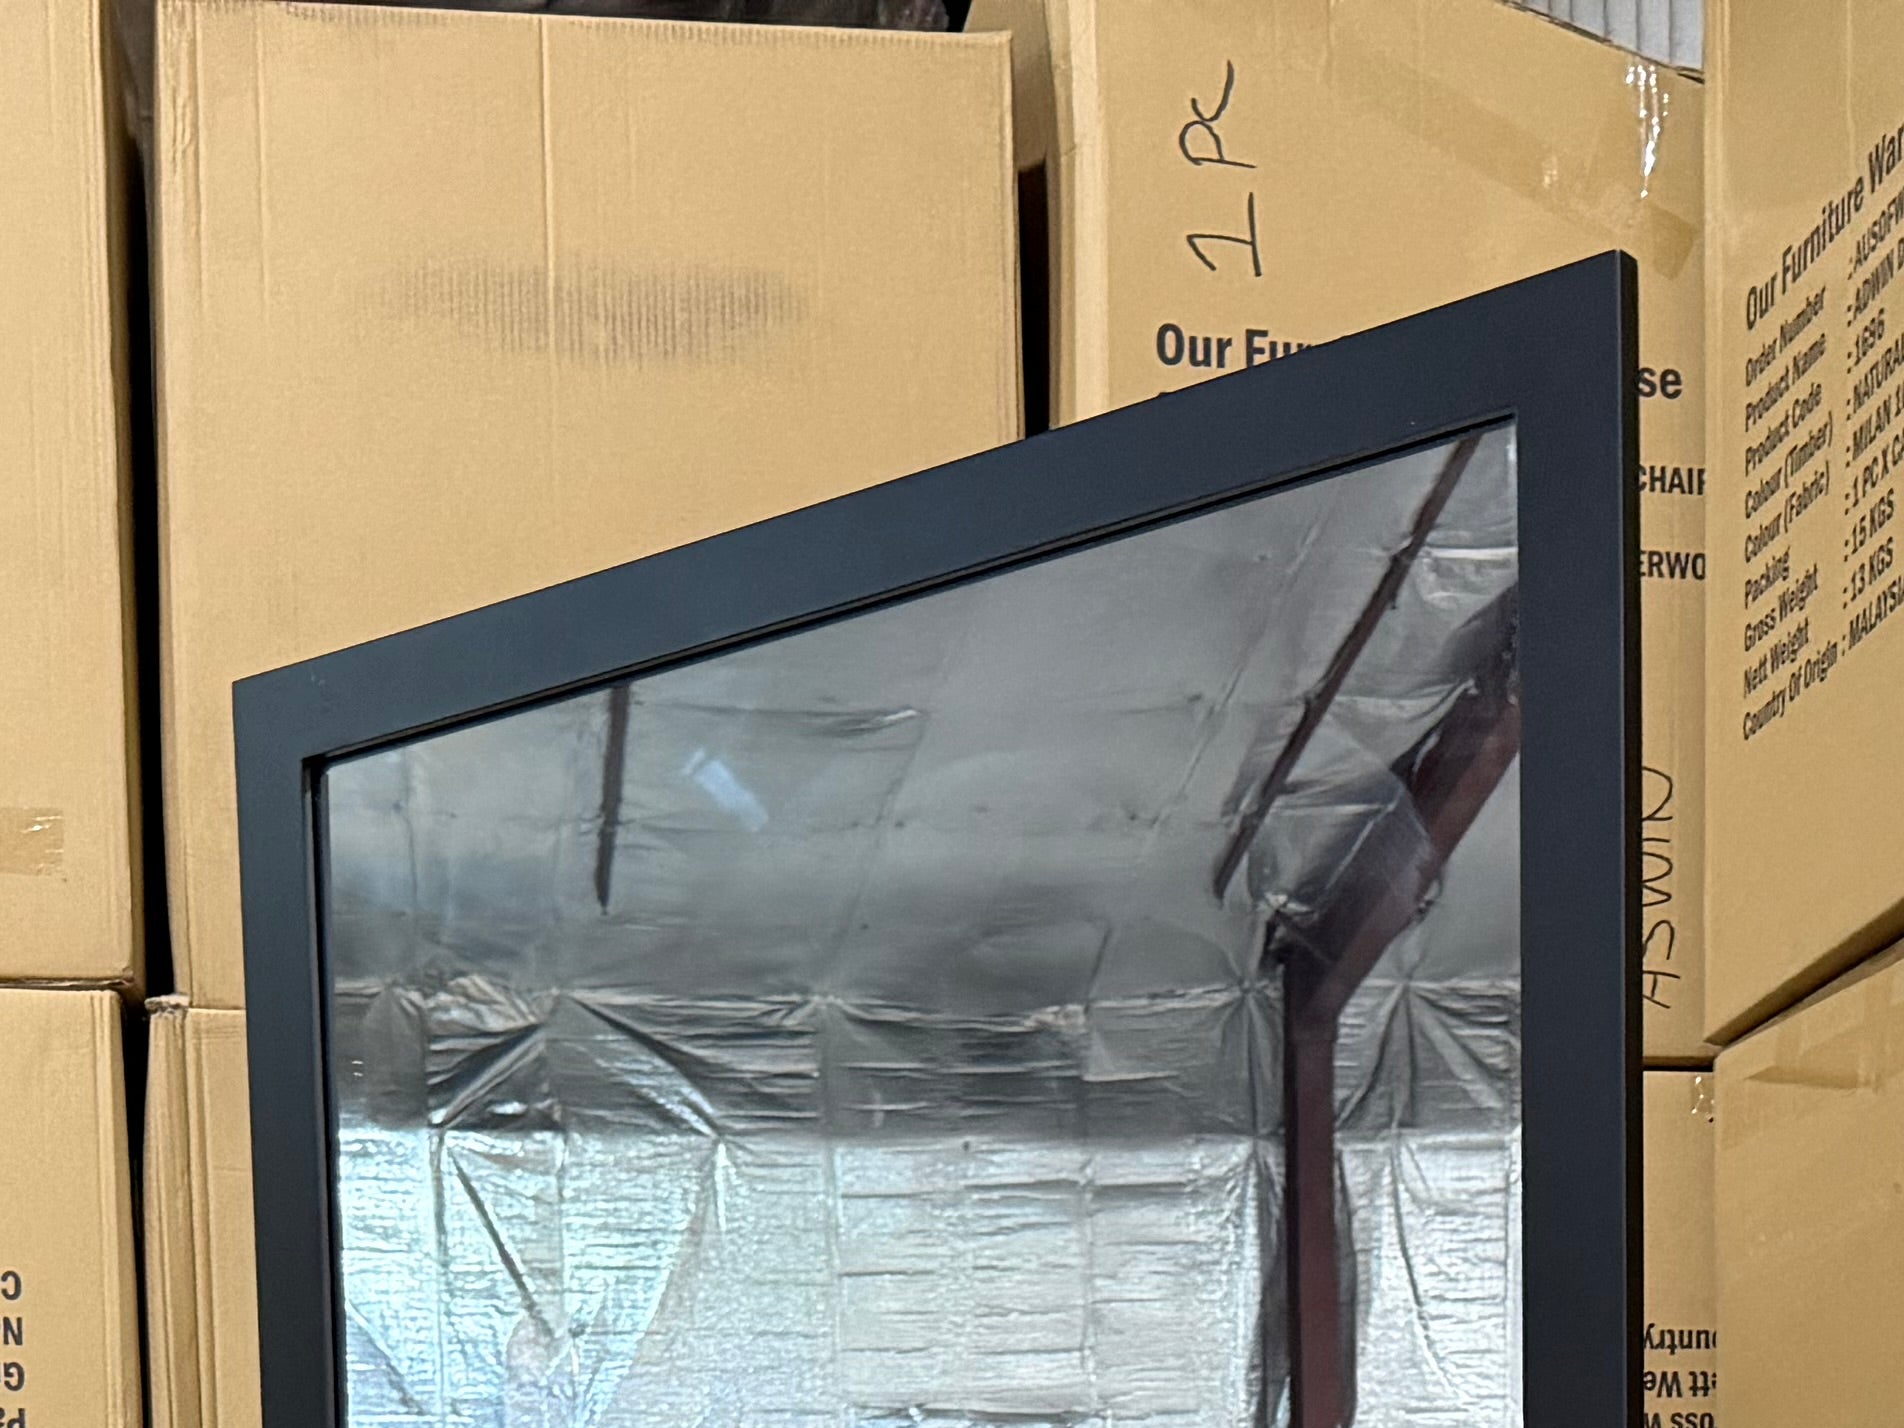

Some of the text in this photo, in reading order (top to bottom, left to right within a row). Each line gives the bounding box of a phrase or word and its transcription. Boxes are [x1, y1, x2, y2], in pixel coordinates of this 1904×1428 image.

[1746, 272, 1777, 331] Our
[1782, 176, 1864, 295] Furniture
[1156, 323, 1232, 368] Our
[1743, 688, 1786, 741] Country
[1789, 666, 1802, 702] Of
[1804, 640, 1838, 689] Origin
